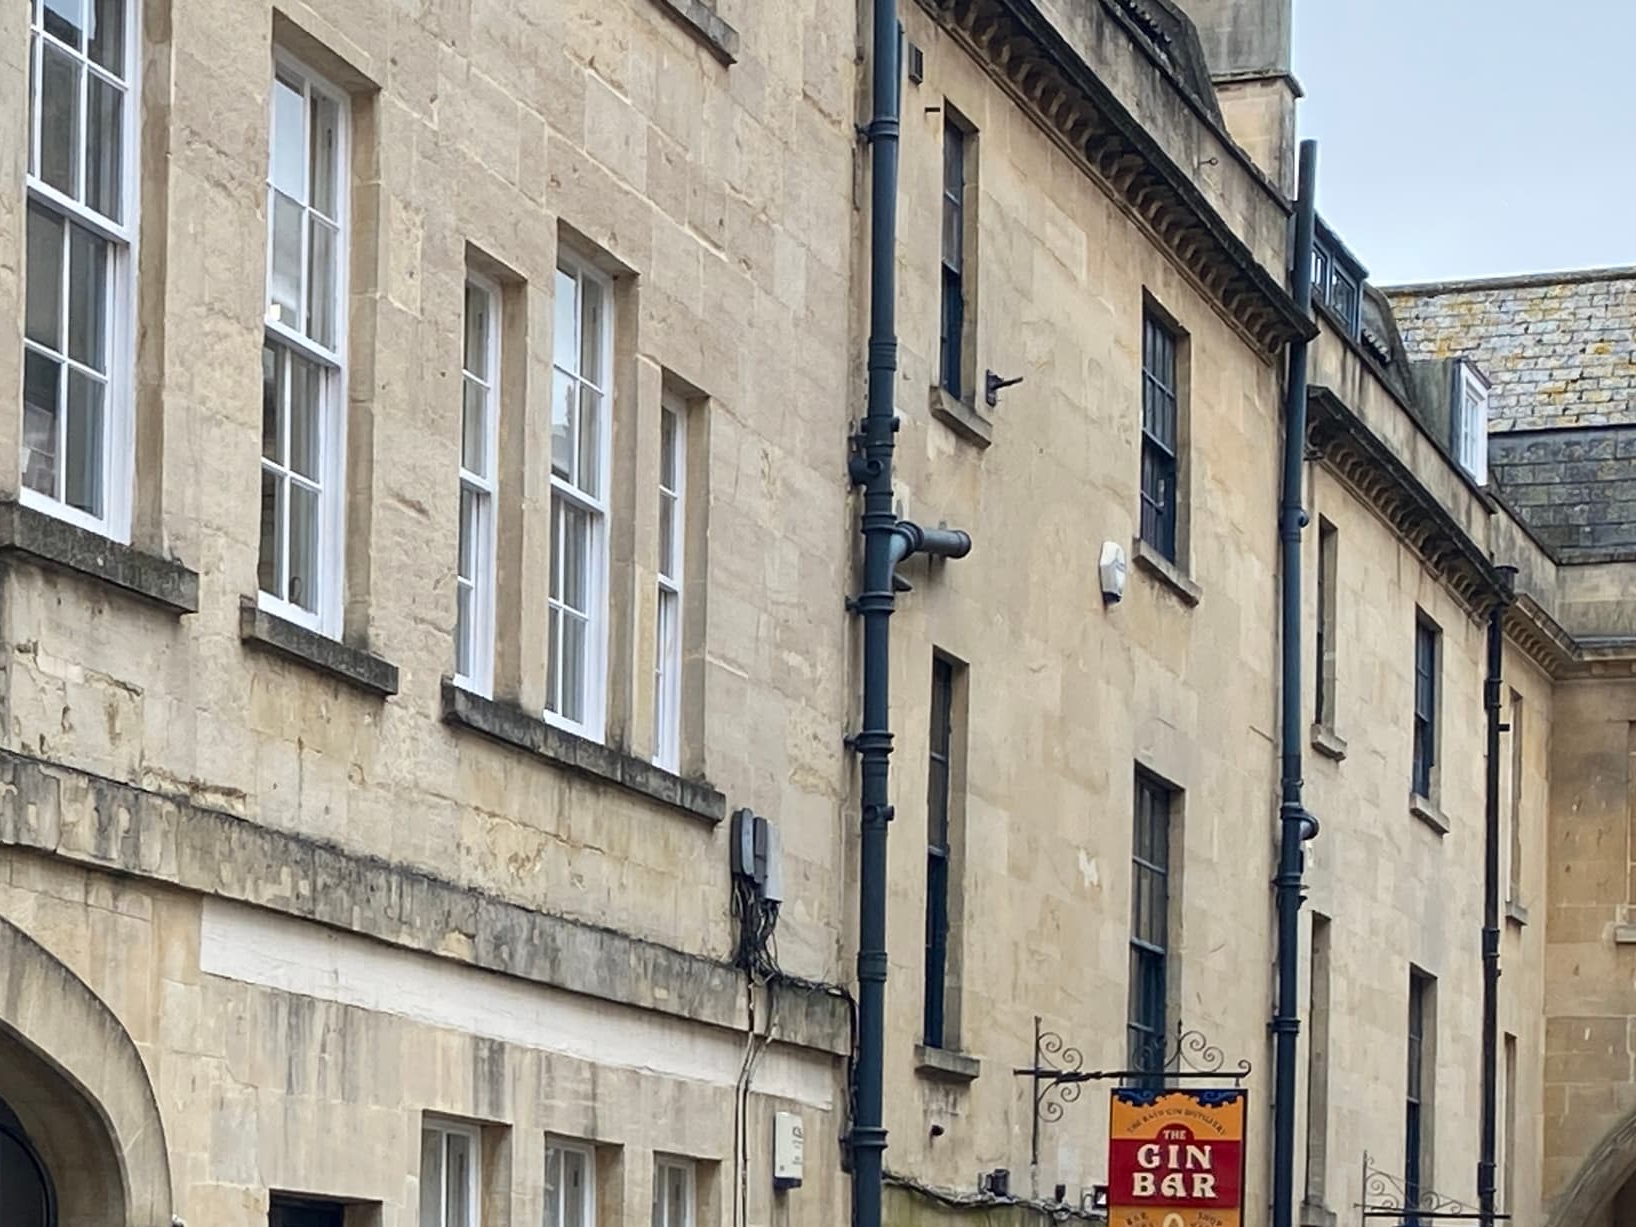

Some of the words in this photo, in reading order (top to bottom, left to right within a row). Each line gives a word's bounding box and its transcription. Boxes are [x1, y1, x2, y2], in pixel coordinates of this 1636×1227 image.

[1163, 1130, 1187, 1140] THE
[1137, 1143, 1212, 1169] GIN
[1132, 1172, 1217, 1198] BAR
